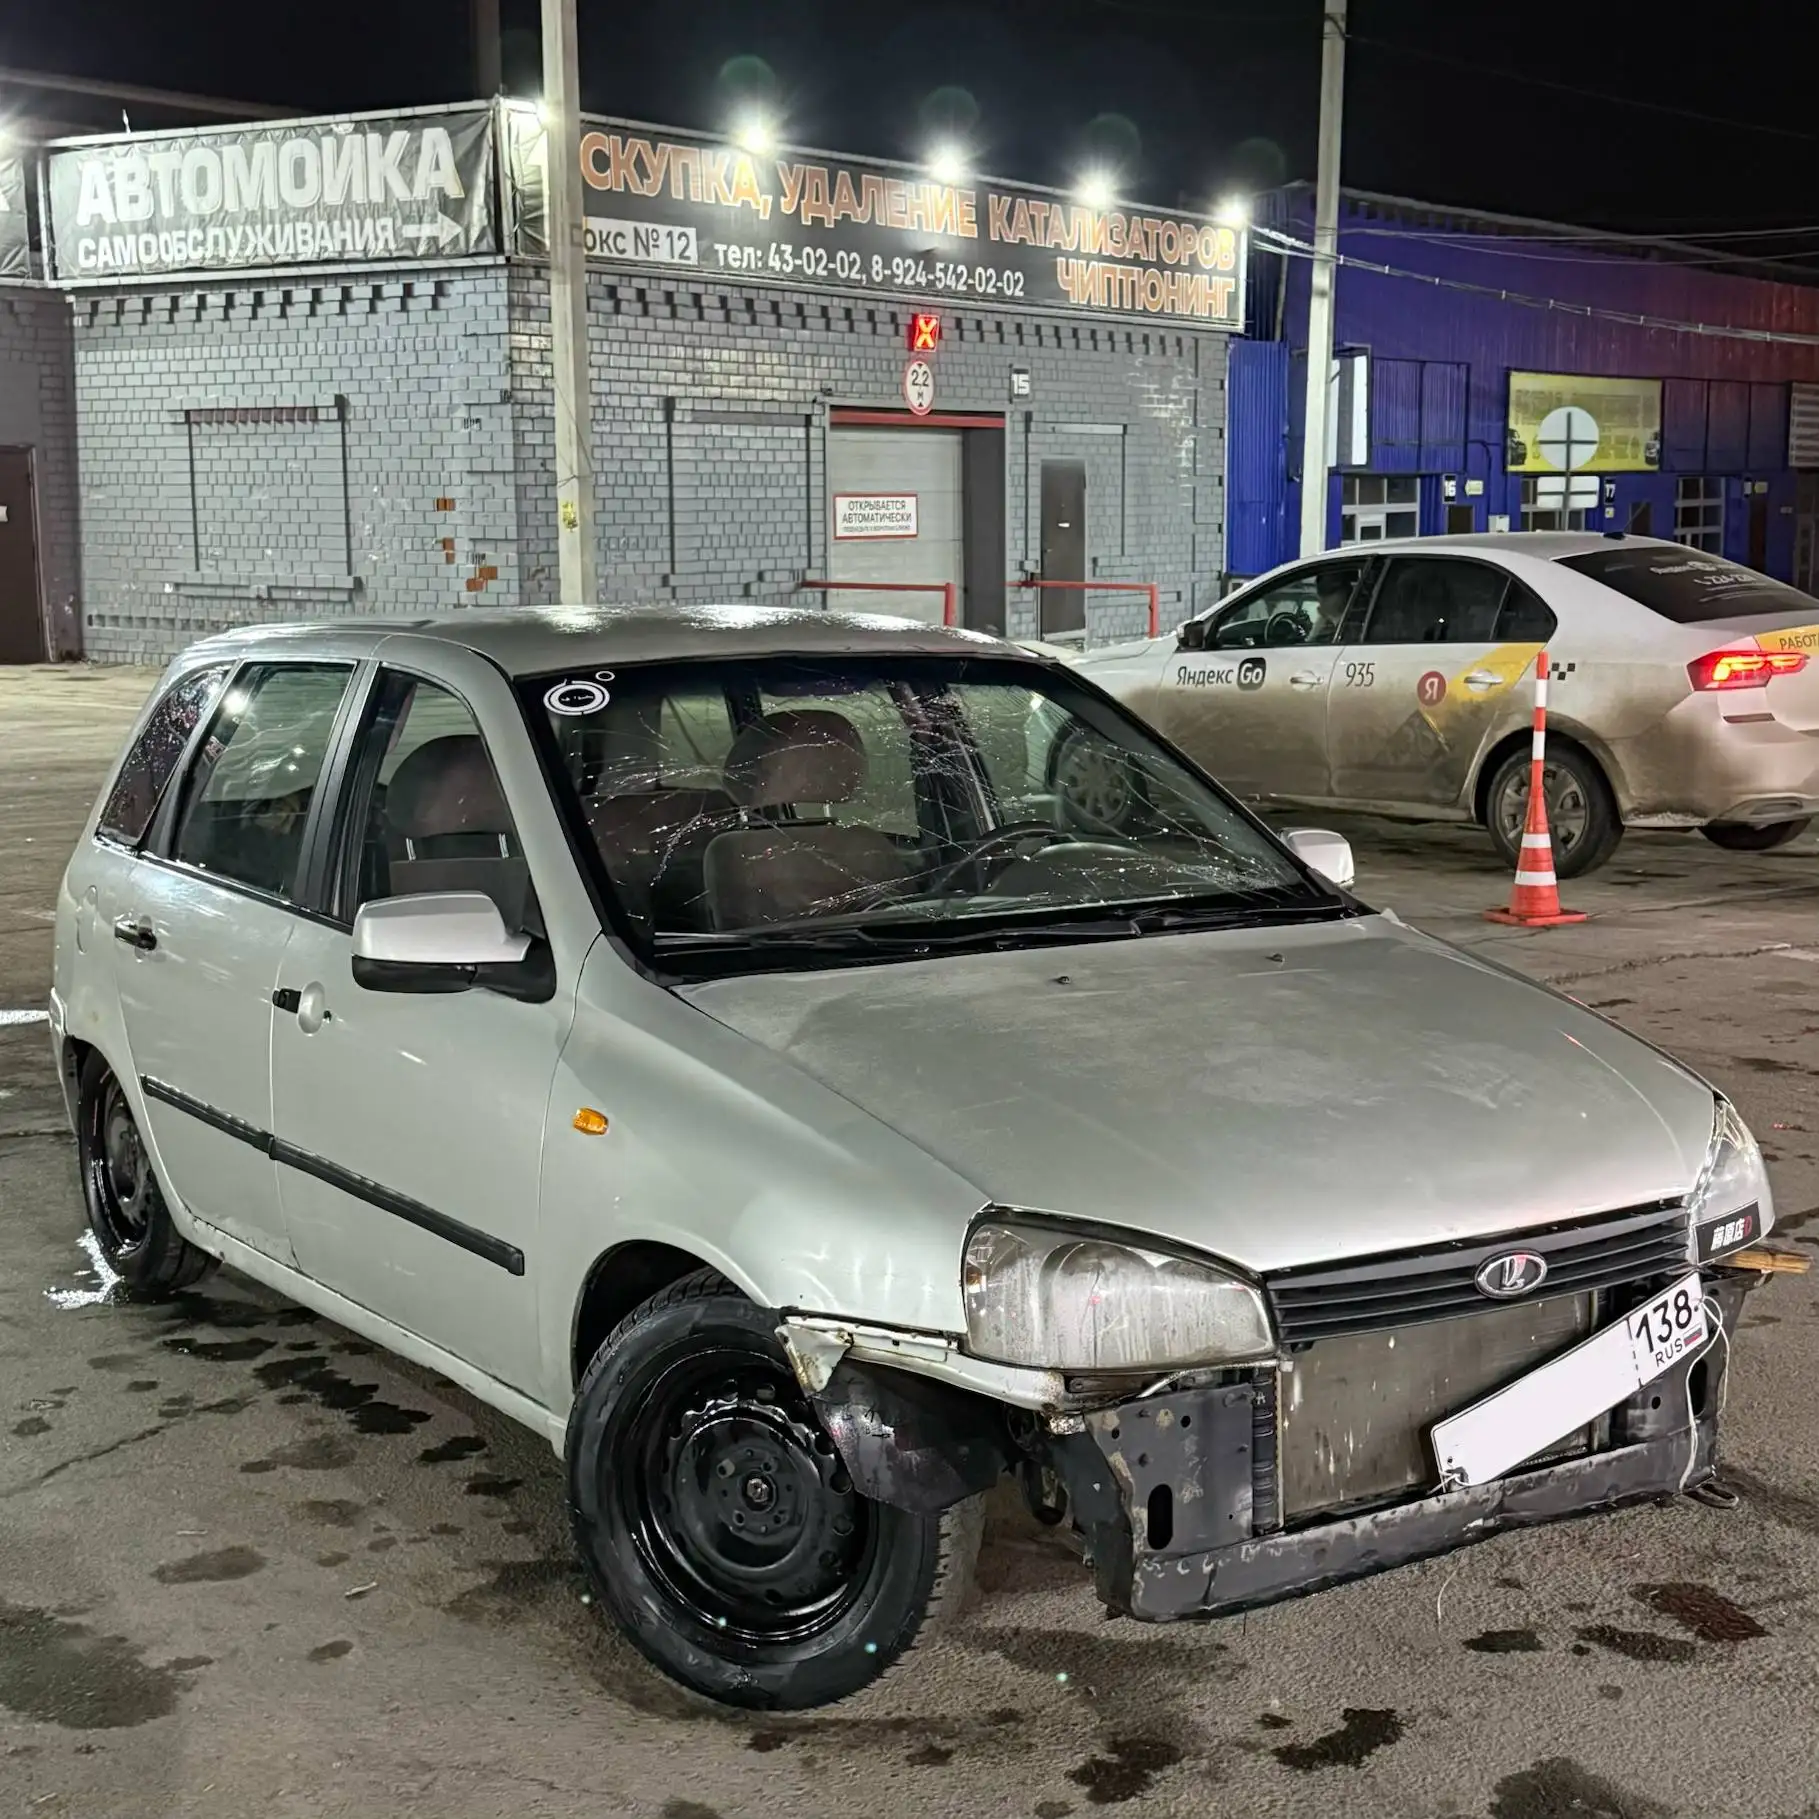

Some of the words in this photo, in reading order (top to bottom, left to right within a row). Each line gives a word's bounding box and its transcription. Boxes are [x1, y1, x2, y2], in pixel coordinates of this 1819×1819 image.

[75, 122, 466, 226] АВТОМОЙКА
[580, 131, 773, 219] СКУПКА,
[777, 160, 979, 238] УДАЛЕНИЕ
[988, 193, 1237, 271] КАТАЛИЗАТОРОВ
[78, 216, 397, 268] САМООБСЛУЖИВАНИЯ
[713, 242, 763, 269] тел:
[767, 242, 867, 285] 43-02-02,
[871, 254, 1025, 298] 8-924-542-02-02
[1056, 256, 1236, 319] ЧИПТЮНИНГ
[1011, 373, 1030, 395] 15
[842, 512, 912, 524] АВТОМАТИЧЕСКИ
[848, 500, 906, 511] ОТКРЫВАЕТСЯ
[1779, 633, 1819, 651] РАБОТ
[1176, 666, 1234, 688] Яндекс
[1240, 661, 1264, 685] Go
[1345, 662, 1375, 688] 935
[1635, 1288, 1693, 1354] 138
[1655, 1337, 1684, 1368] RUS
